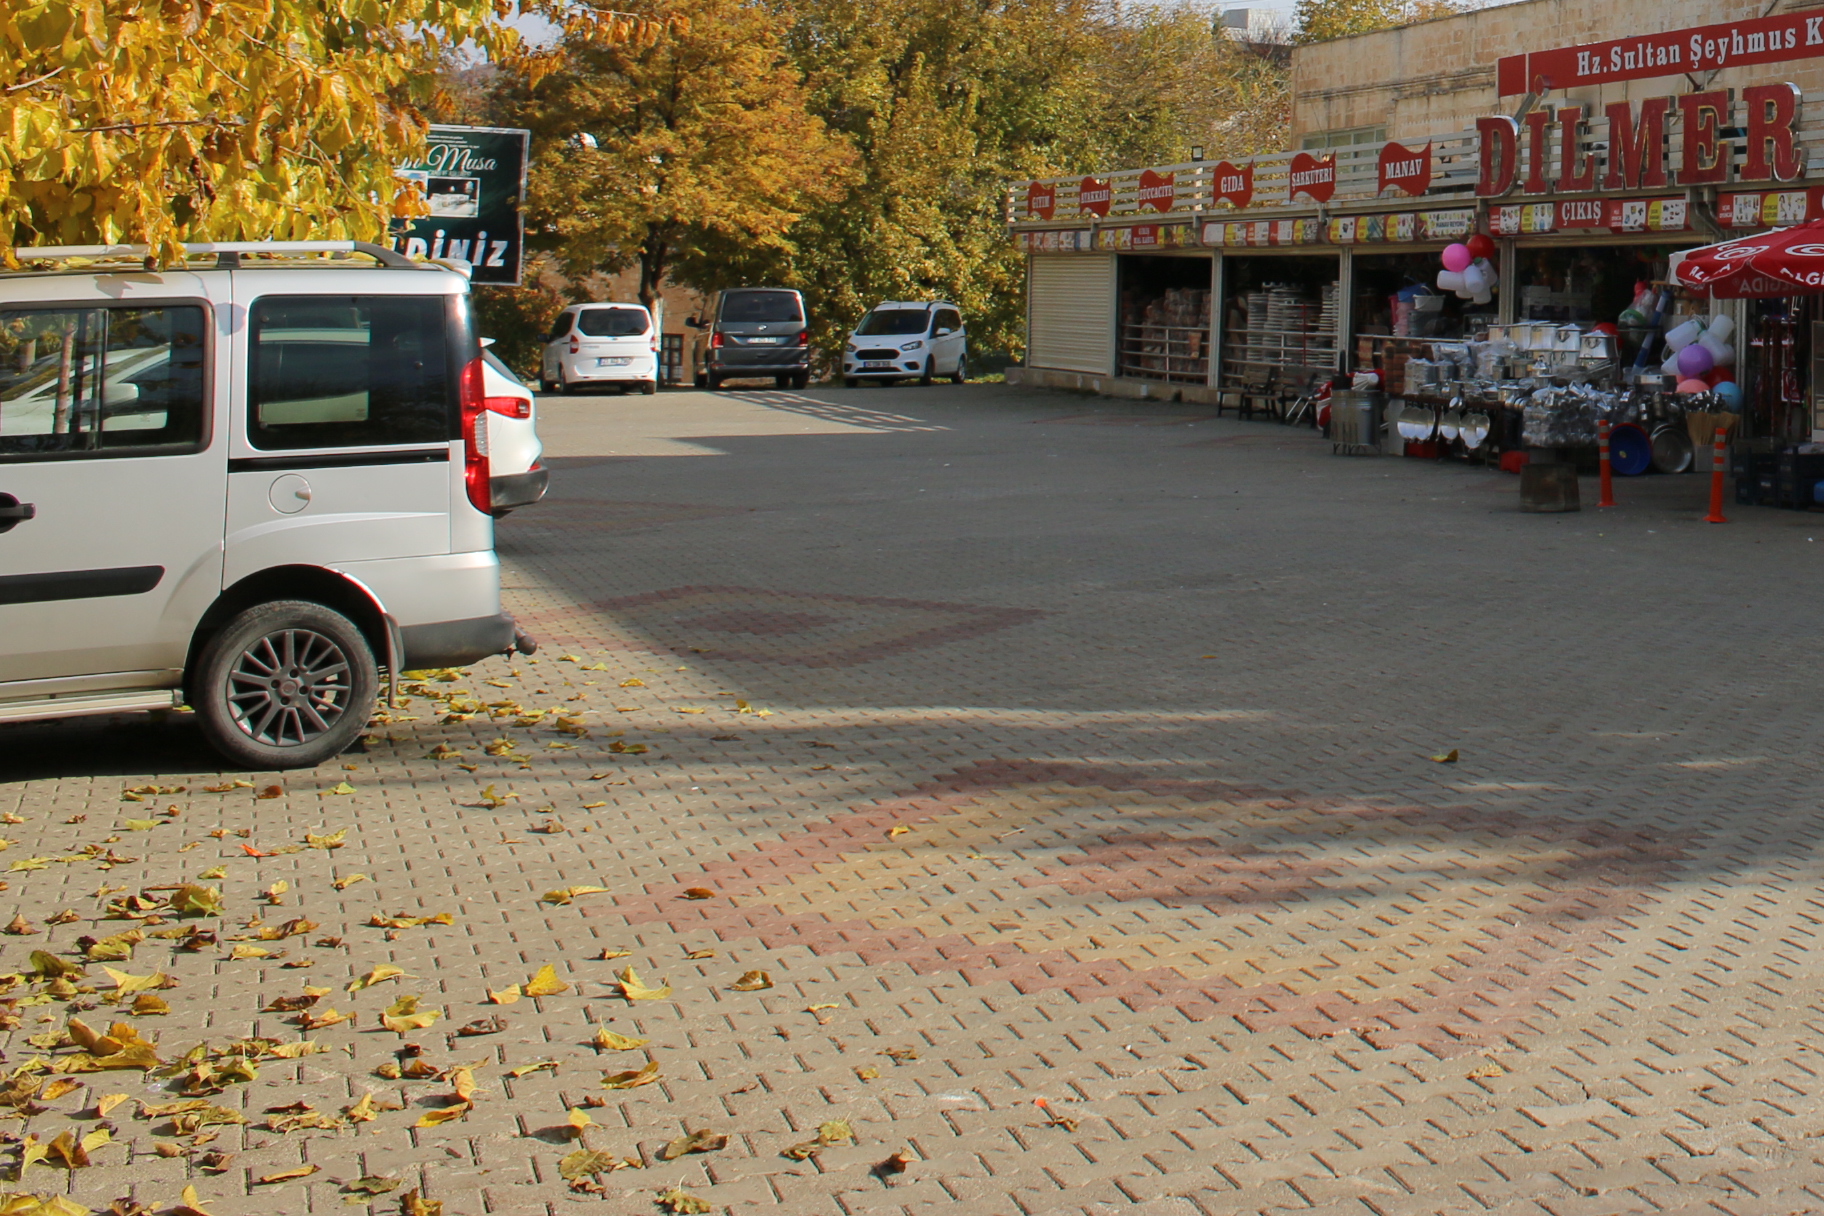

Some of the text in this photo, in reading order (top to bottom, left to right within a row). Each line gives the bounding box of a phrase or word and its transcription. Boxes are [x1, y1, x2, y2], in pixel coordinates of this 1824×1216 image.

[1689, 21, 1797, 69] Şeyhmus
[1475, 76, 1802, 198] DİLMER
[427, 144, 497, 172] Musa
[1385, 159, 1423, 180] MANAV
[1221, 174, 1244, 193] GIDA
[1292, 164, 1333, 191] ŞARKÜTERİ
[1562, 200, 1601, 225] ÇIKIŞ
